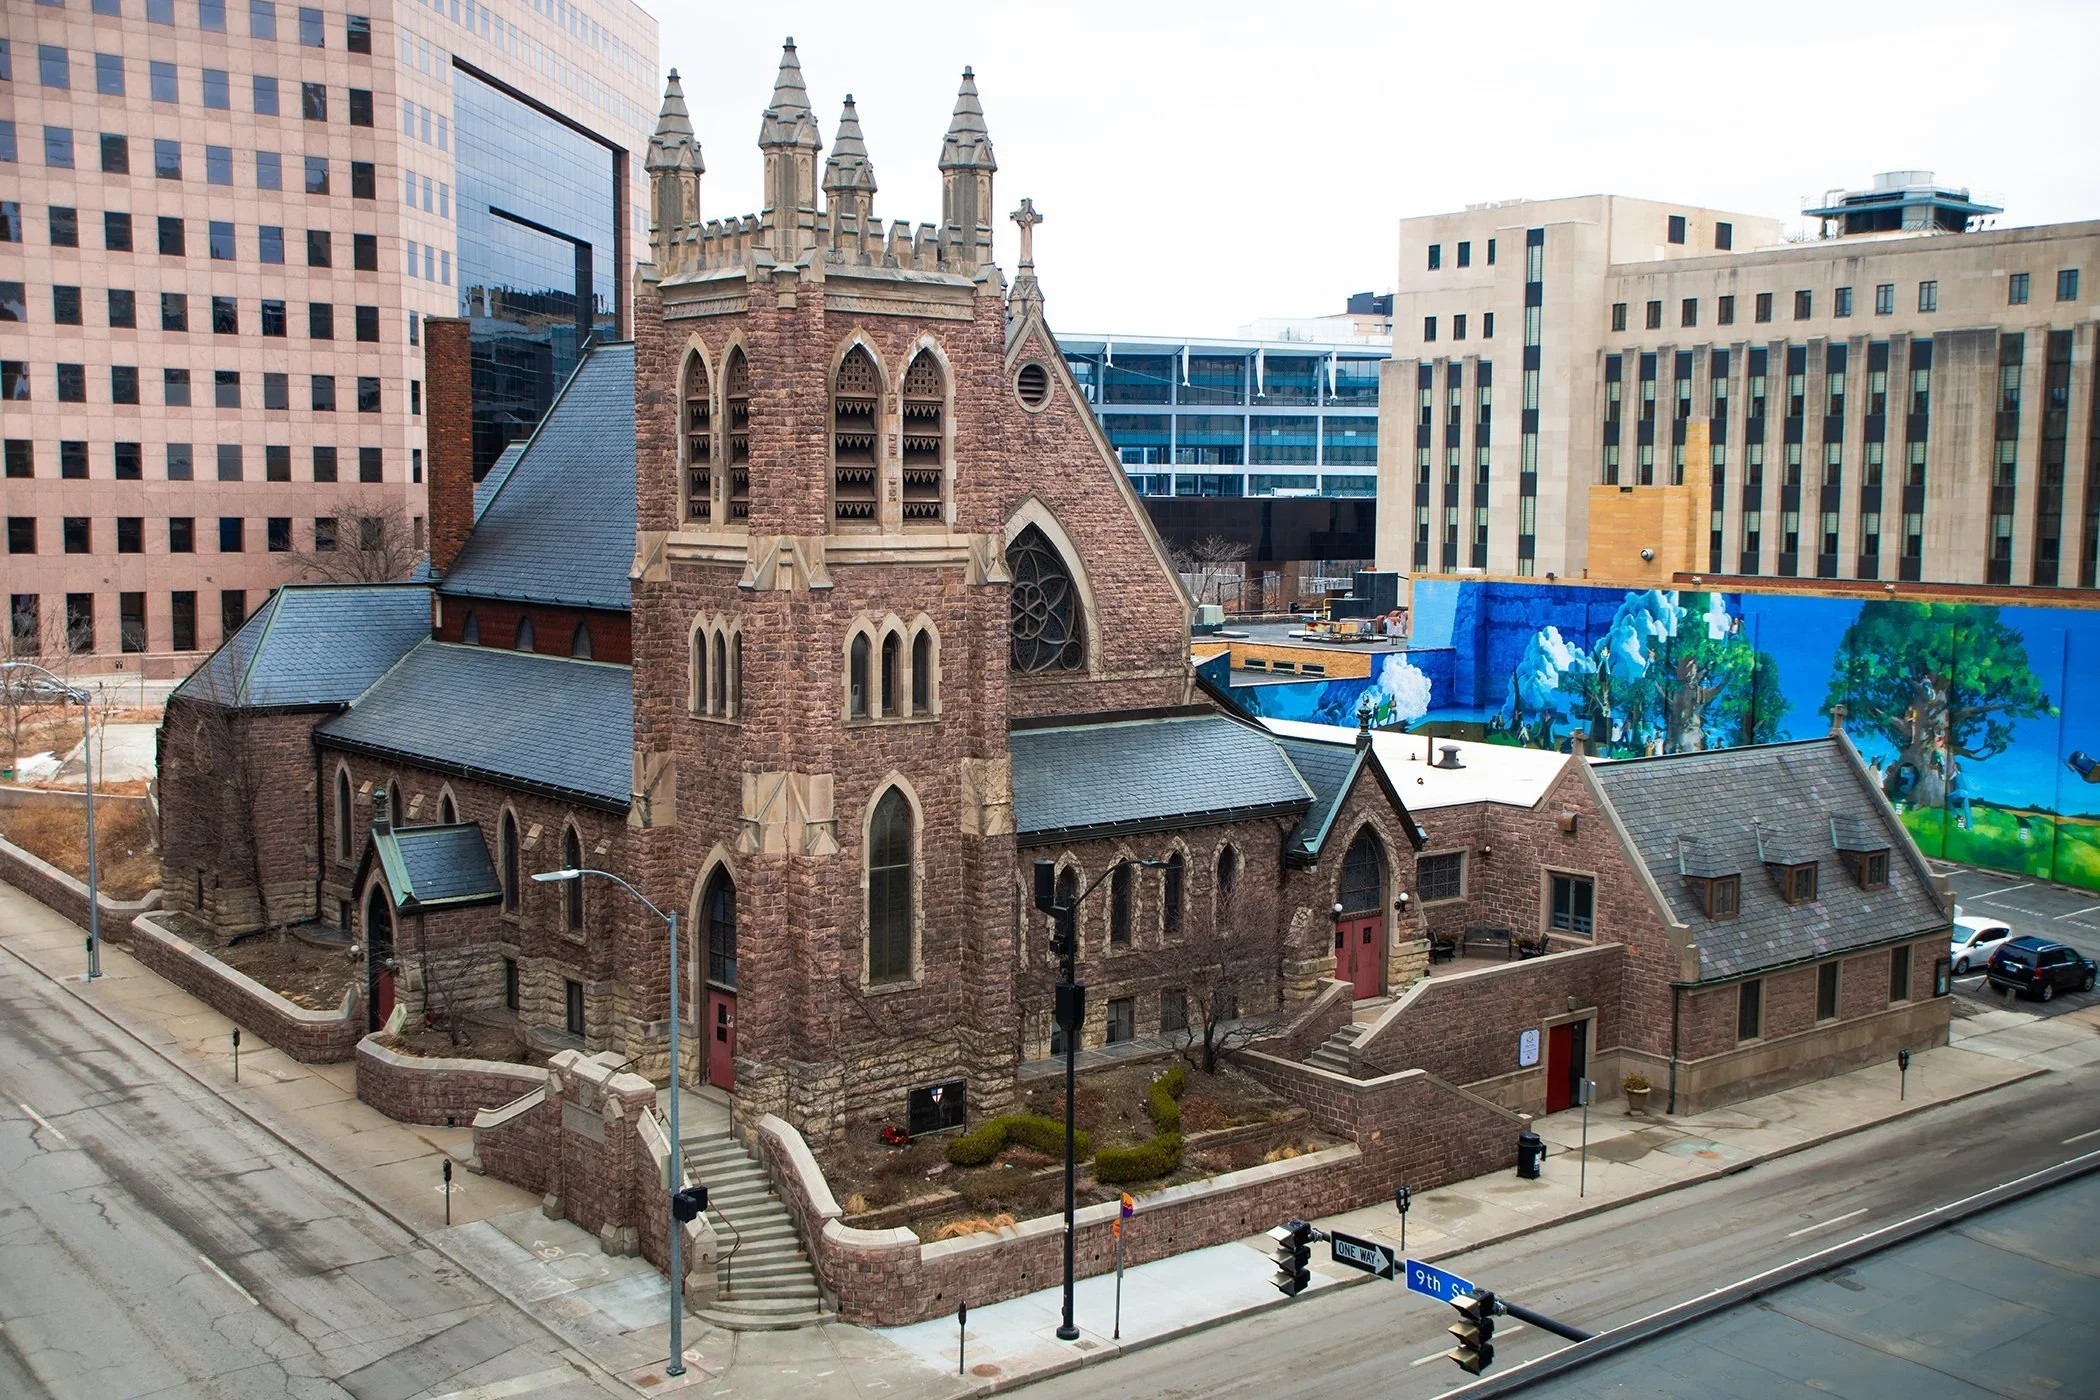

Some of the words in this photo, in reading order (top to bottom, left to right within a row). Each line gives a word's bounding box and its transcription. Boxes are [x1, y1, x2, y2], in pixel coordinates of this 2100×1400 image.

[1338, 1242, 1356, 1258] ONE
[1359, 1248, 1376, 1264] WAY
[1415, 1269, 1441, 1292] 9th
